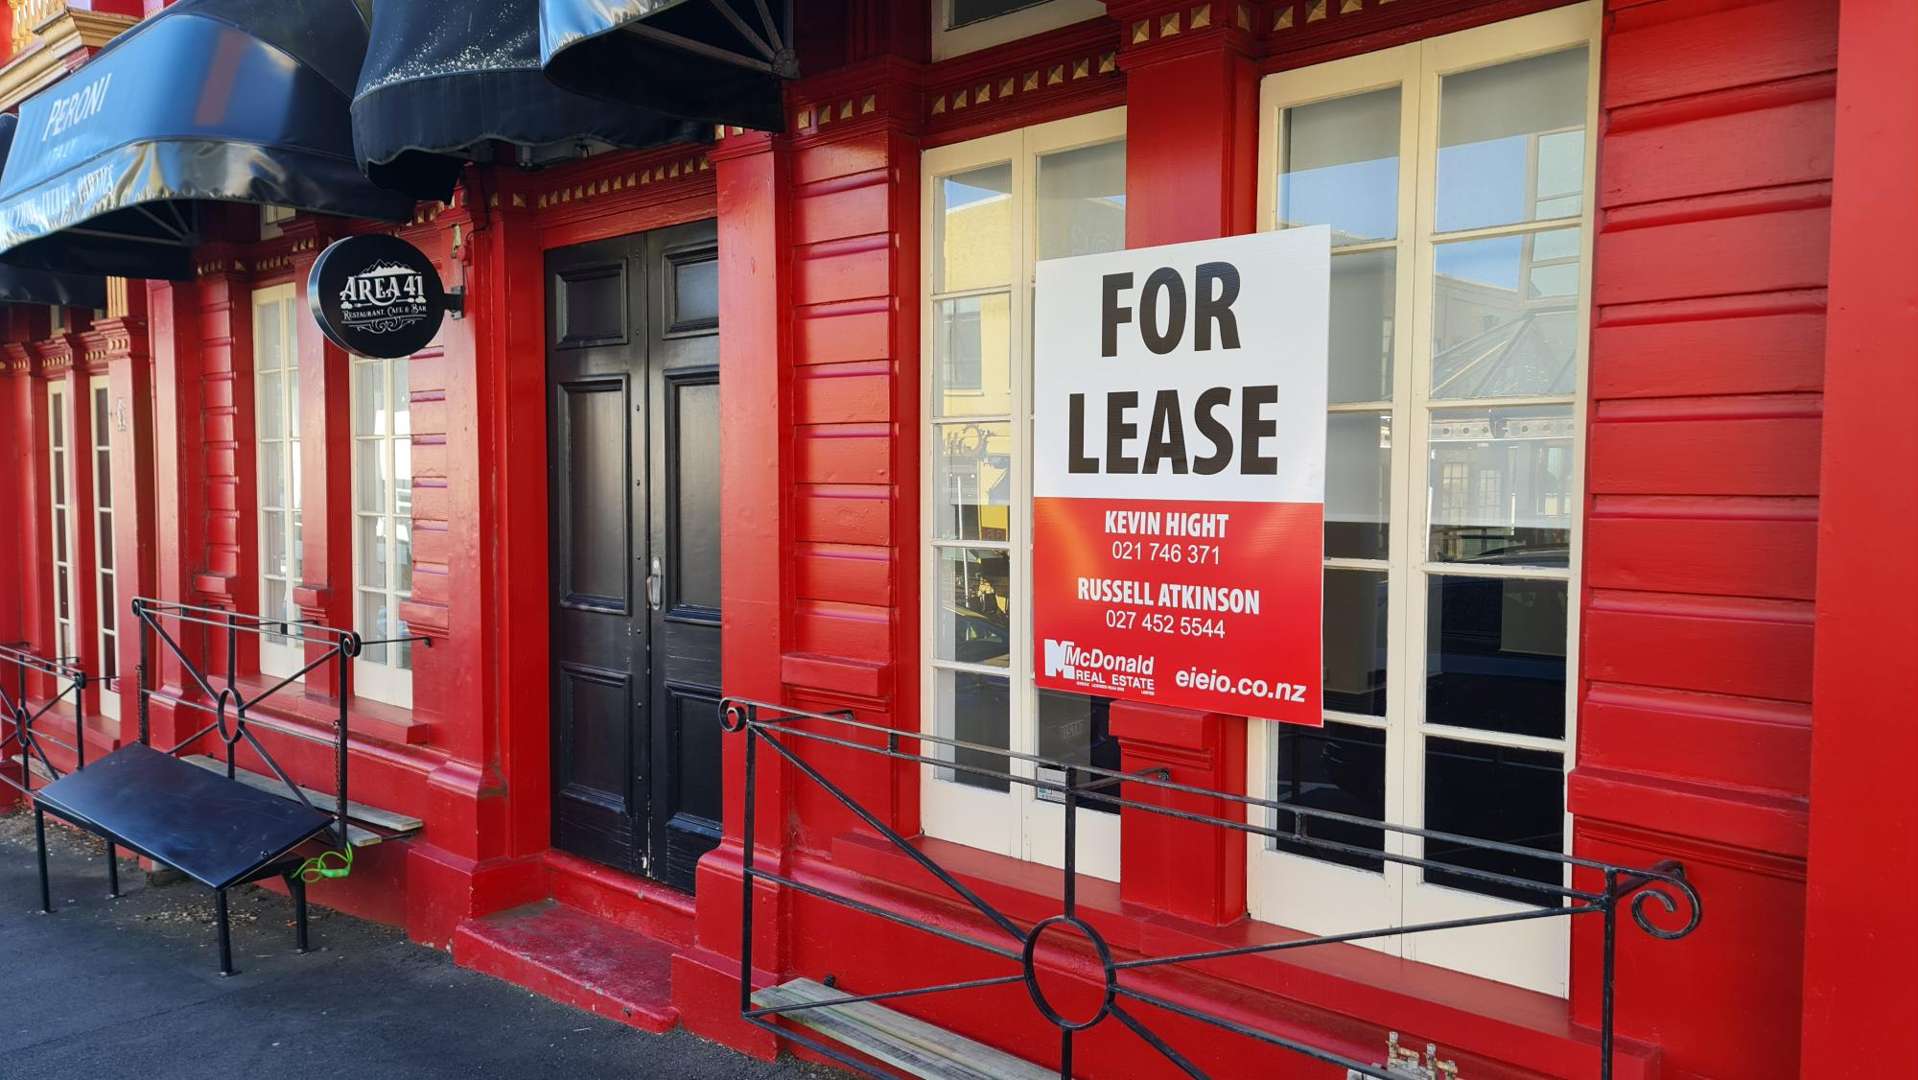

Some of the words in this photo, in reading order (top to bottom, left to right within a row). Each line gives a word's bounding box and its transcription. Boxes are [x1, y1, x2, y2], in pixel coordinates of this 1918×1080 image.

[42, 73, 112, 142] PERONI
[340, 276, 401, 306] AREA
[403, 275, 425, 297] 41
[1101, 261, 1241, 357] FOR
[1068, 385, 1278, 475] LEASE
[1105, 510, 1160, 535] KEVIN
[1165, 513, 1229, 538] HIGHT
[1112, 541, 1142, 560] 021
[1149, 543, 1181, 563] 746
[1187, 545, 1220, 565] 371
[1077, 577, 1154, 606] RUSSELL
[1159, 584, 1260, 615] ATKINSON
[1106, 610, 1136, 629] 027
[1142, 613, 1174, 633] 452
[1180, 617, 1225, 639] 5544
[1065, 646, 1155, 675] McDonald
[1076, 669, 1106, 684] REAL
[1112, 674, 1155, 690] ESTATE
[1175, 667, 1307, 702] eieio.co.nz
